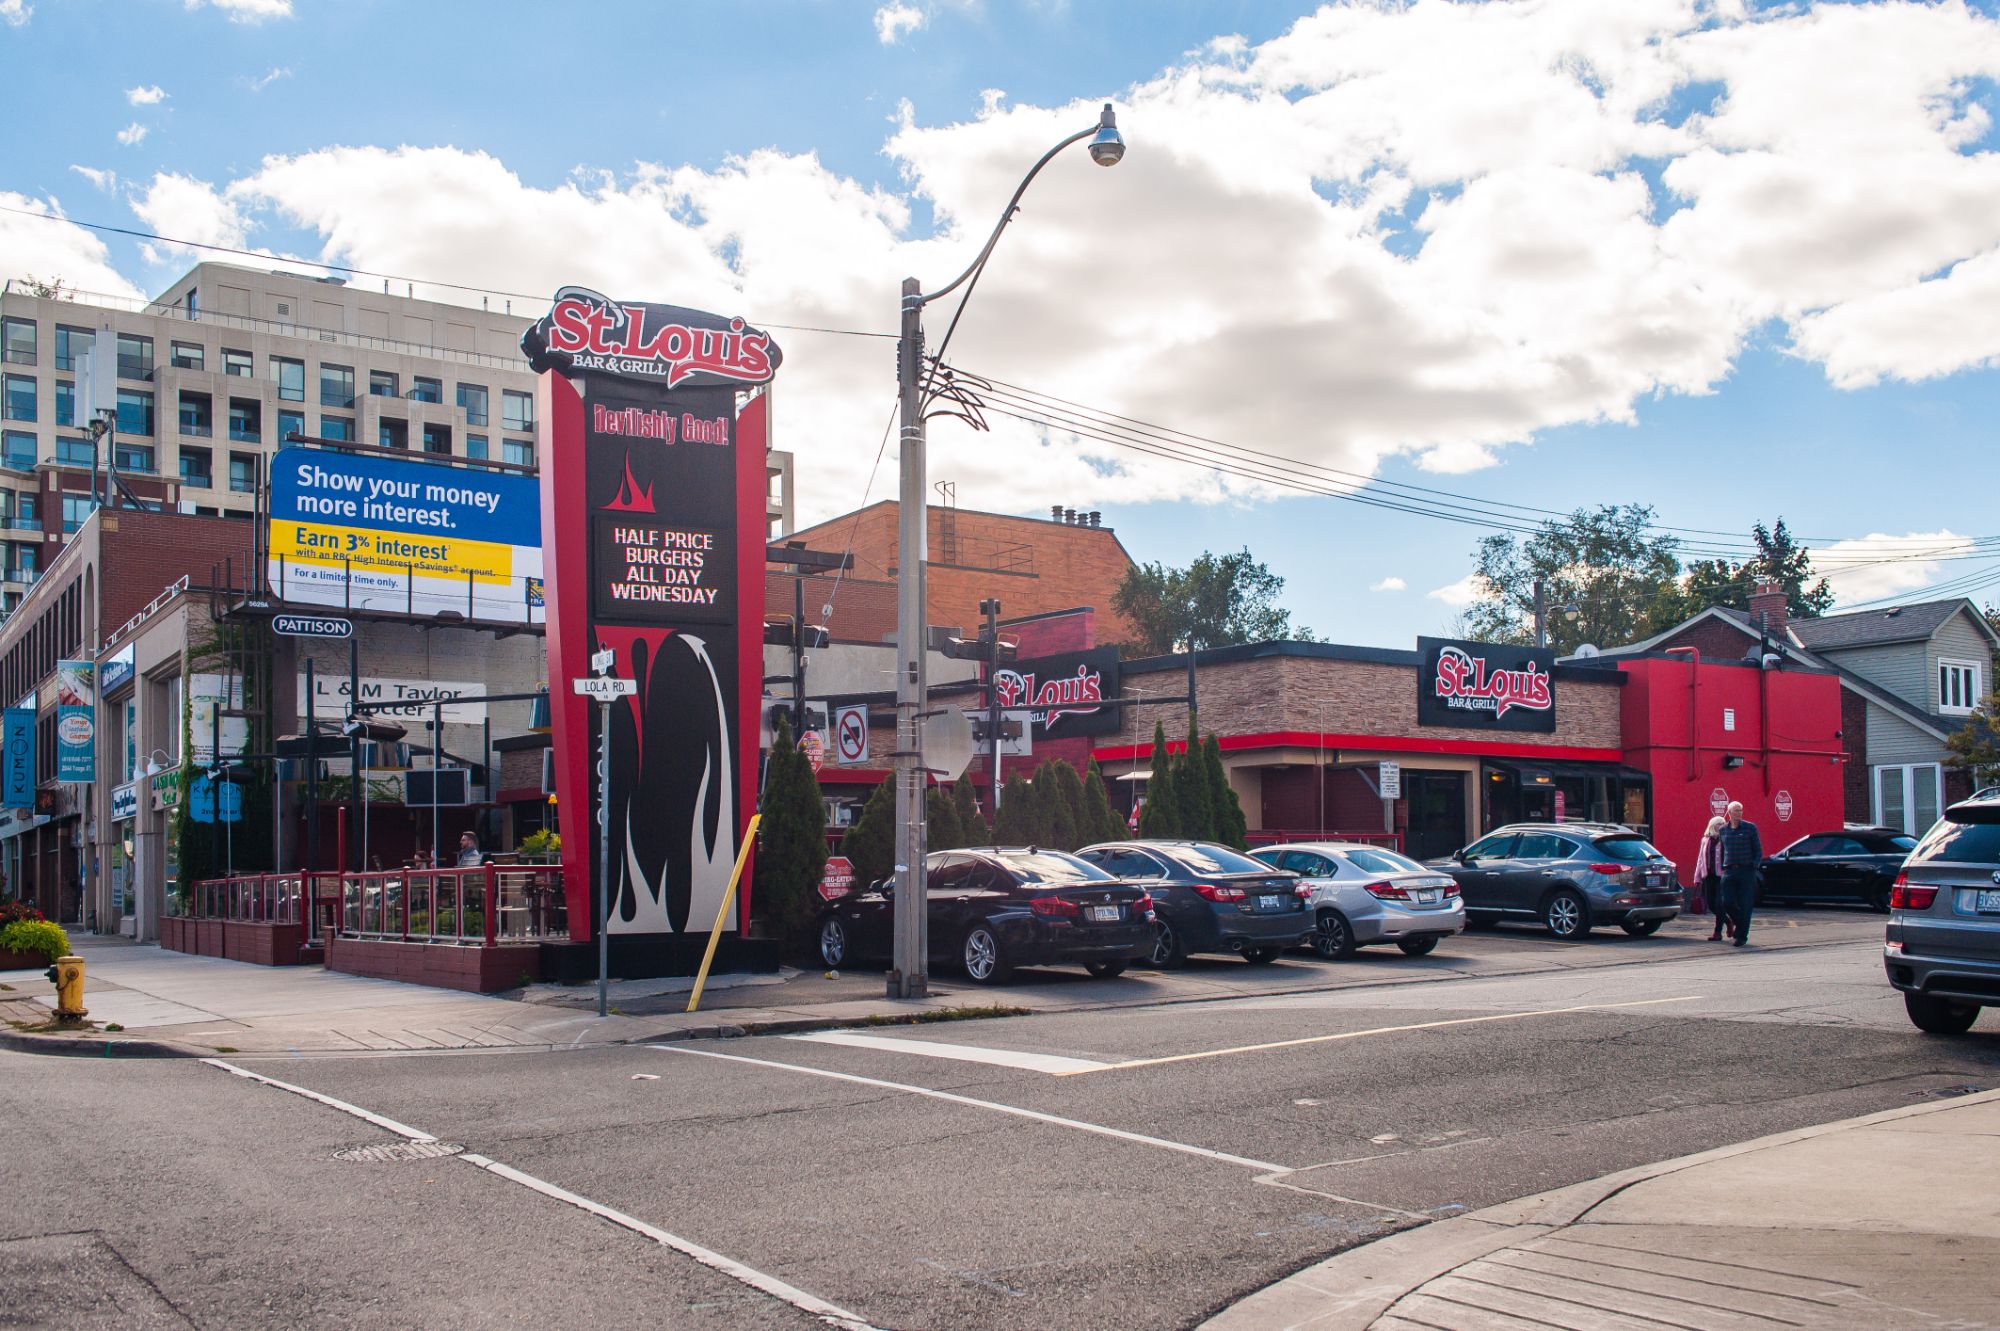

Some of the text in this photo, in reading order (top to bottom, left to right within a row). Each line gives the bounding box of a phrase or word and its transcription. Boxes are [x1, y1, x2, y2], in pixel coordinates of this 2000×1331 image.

[594, 403, 729, 446] Devilishly Good!
[297, 464, 500, 513] Show your money
[297, 495, 456, 528] more interest.
[296, 527, 339, 549] Earn
[346, 534, 370, 551] 3%
[614, 528, 713, 550] HALF PRICE
[296, 548, 316, 558] with
[333, 552, 351, 560] RBC
[354, 554, 375, 565] High
[378, 557, 411, 567] Interest
[626, 548, 704, 568] BURGERS
[295, 568, 308, 577] For
[311, 570, 317, 579] a
[355, 575, 375, 585] time
[377, 577, 399, 589] only.
[626, 566, 702, 585] ALL DAY
[612, 583, 718, 605] WEDNESDAY
[279, 619, 346, 634] PATTISON
[317, 681, 462, 701] L & M Taylor
[584, 681, 626, 692] LOLA RD.
[997, 664, 1101, 706] StLouis
[357, 700, 426, 716] occer
[10, 726, 29, 794] KUMON
